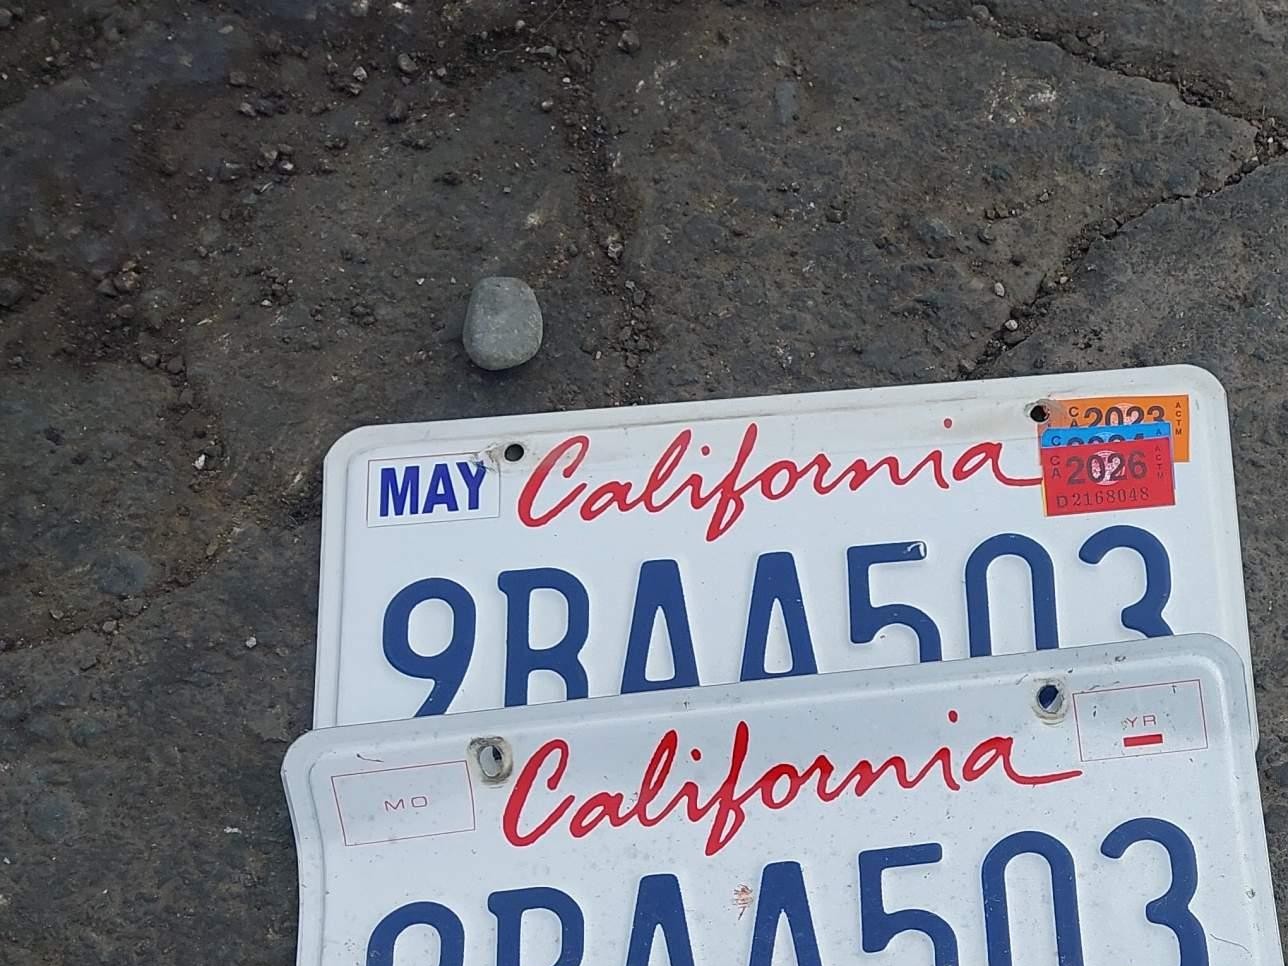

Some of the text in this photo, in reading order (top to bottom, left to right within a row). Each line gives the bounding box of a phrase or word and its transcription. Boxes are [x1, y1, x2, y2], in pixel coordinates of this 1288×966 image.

[380, 460, 486, 518] MAY
[517, 422, 1043, 542] California
[1065, 450, 1148, 486] 2026
[382, 524, 1175, 718] 9BAA503
[1126, 714, 1157, 729] YR
[384, 795, 429, 812] MO
[501, 720, 1083, 856] California
